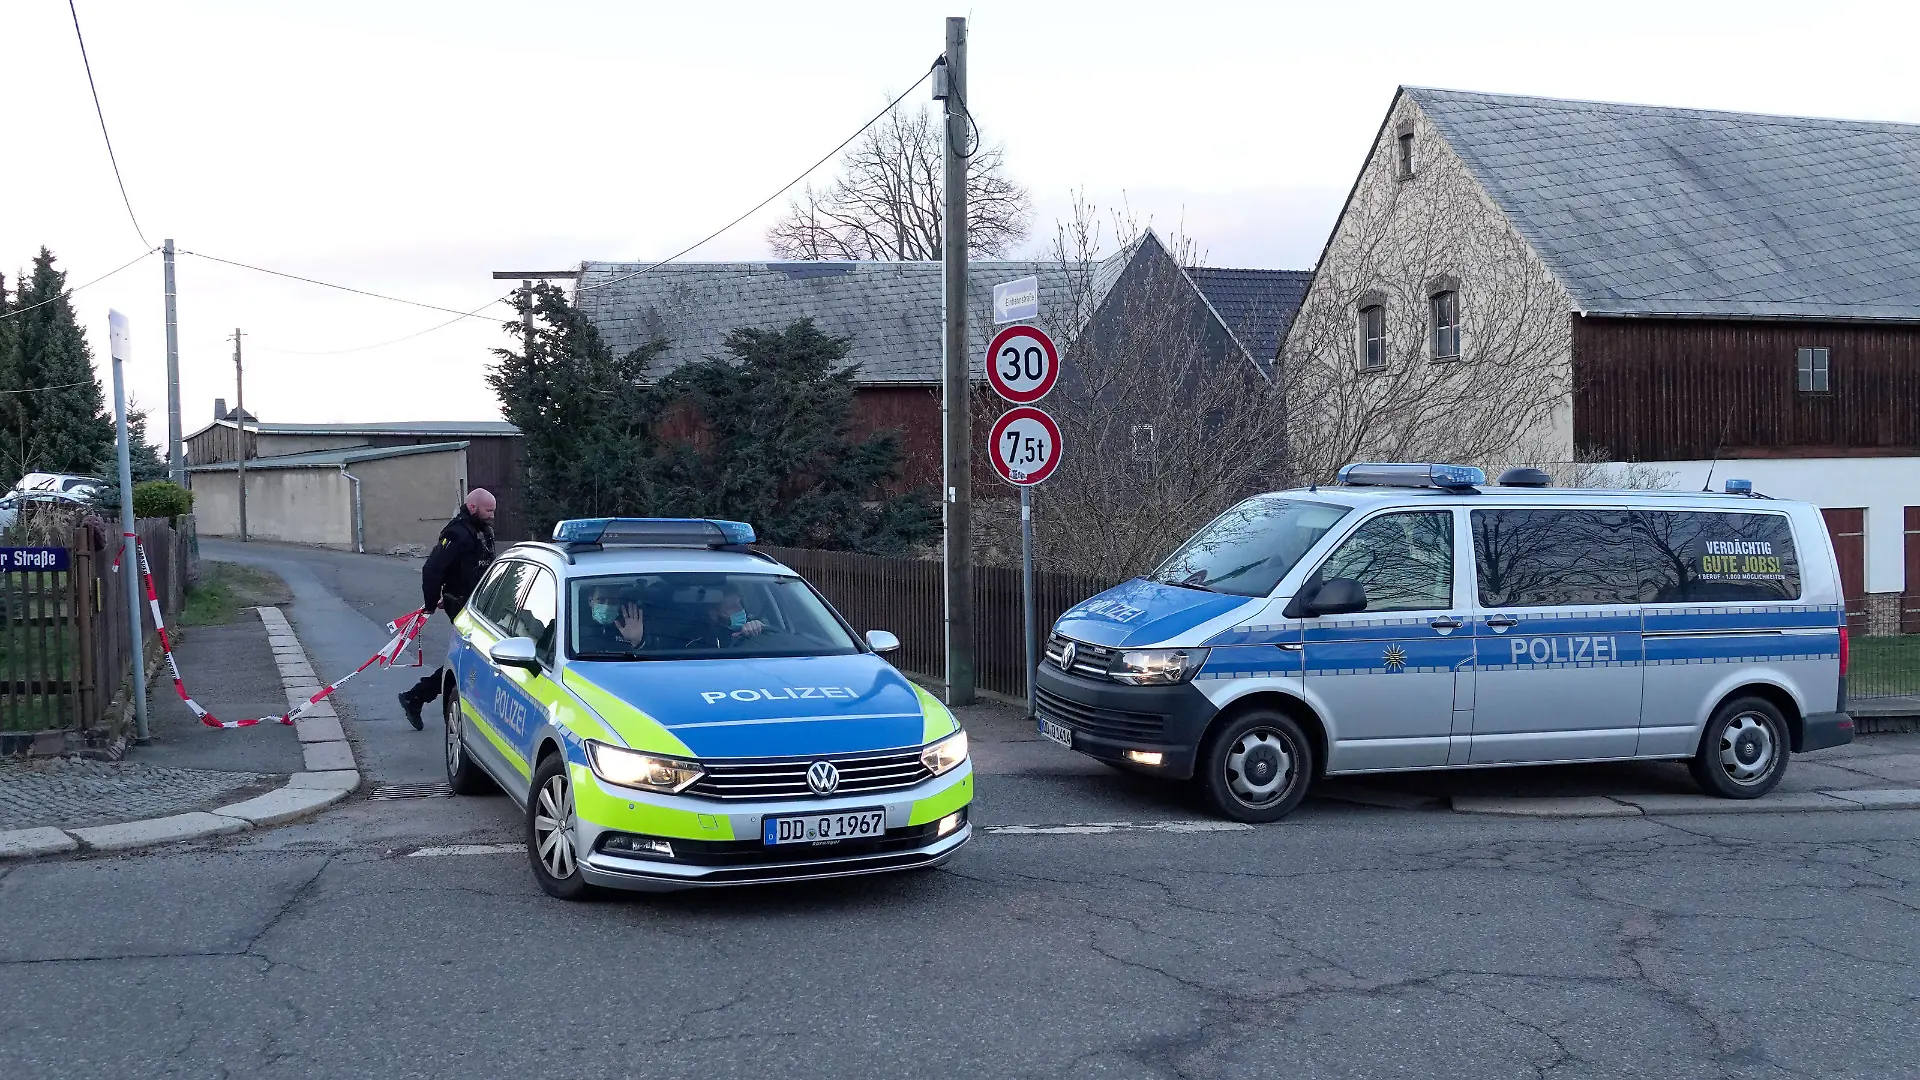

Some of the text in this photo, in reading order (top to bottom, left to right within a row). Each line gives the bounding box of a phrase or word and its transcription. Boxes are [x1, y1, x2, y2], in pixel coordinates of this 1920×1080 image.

[1002, 346, 1043, 381] 30
[1705, 538, 1772, 555] VERDÄCHTIG
[13, 550, 56, 568] Straße
[1702, 555, 1781, 573] GUTE JOBS!
[1742, 572, 1786, 580] MÖGLICHKEITEN
[1511, 636, 1618, 664] POLIZEI
[701, 687, 860, 704] POLIZEI
[494, 685, 527, 737] POLIZEI
[778, 820, 804, 841] DD
[818, 817, 831, 838] Q
[835, 813, 883, 837] 1967
